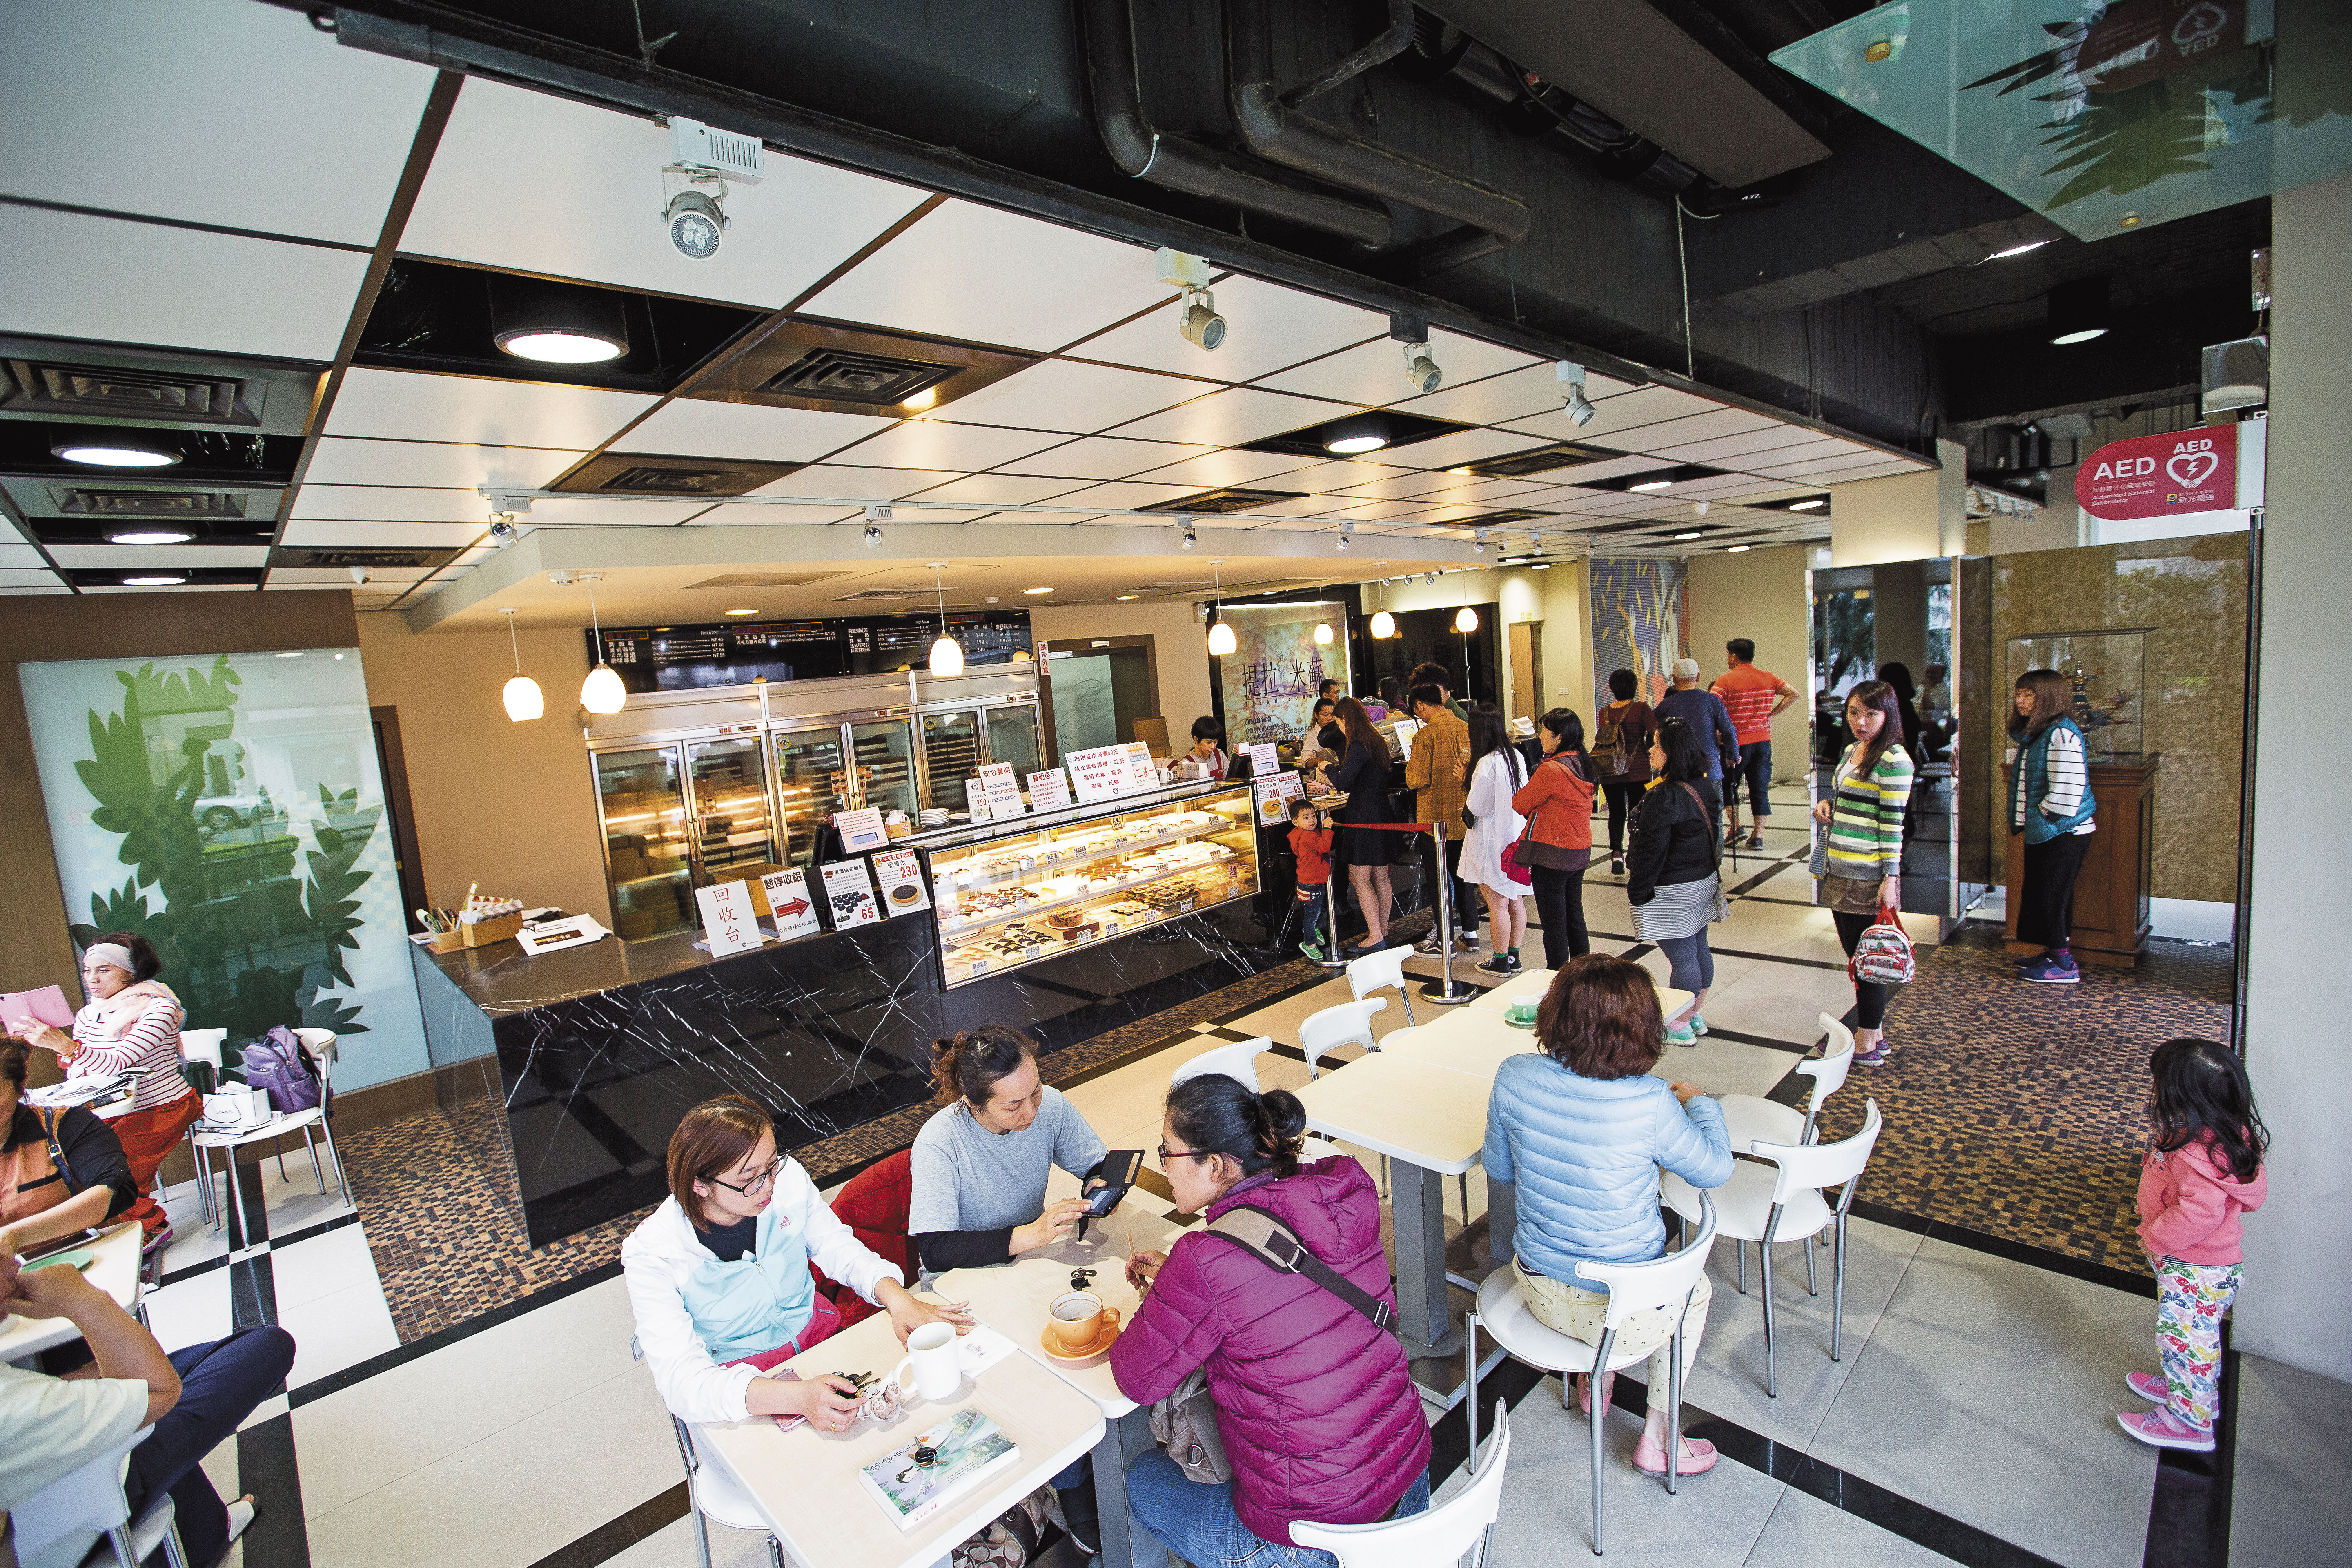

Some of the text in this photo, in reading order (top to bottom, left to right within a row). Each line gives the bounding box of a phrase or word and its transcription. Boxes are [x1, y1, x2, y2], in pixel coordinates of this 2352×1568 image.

[2173, 439, 2213, 454] AED
[2093, 457, 2156, 481] AED
[2092, 492, 2127, 500] Automated
[1242, 657, 1323, 699] 提拉米蘇
[982, 766, 1011, 777] 安心聲明
[1269, 788, 1280, 798] 280
[1294, 785, 1301, 794] 65
[977, 798, 987, 807] 250
[887, 859, 906, 869] 藍莓派
[900, 864, 917, 878] 230
[763, 871, 803, 890] 暫停收銀
[713, 887, 739, 943] 回收台
[861, 906, 873, 920] 65
[779, 1221, 793, 1229] adidas
